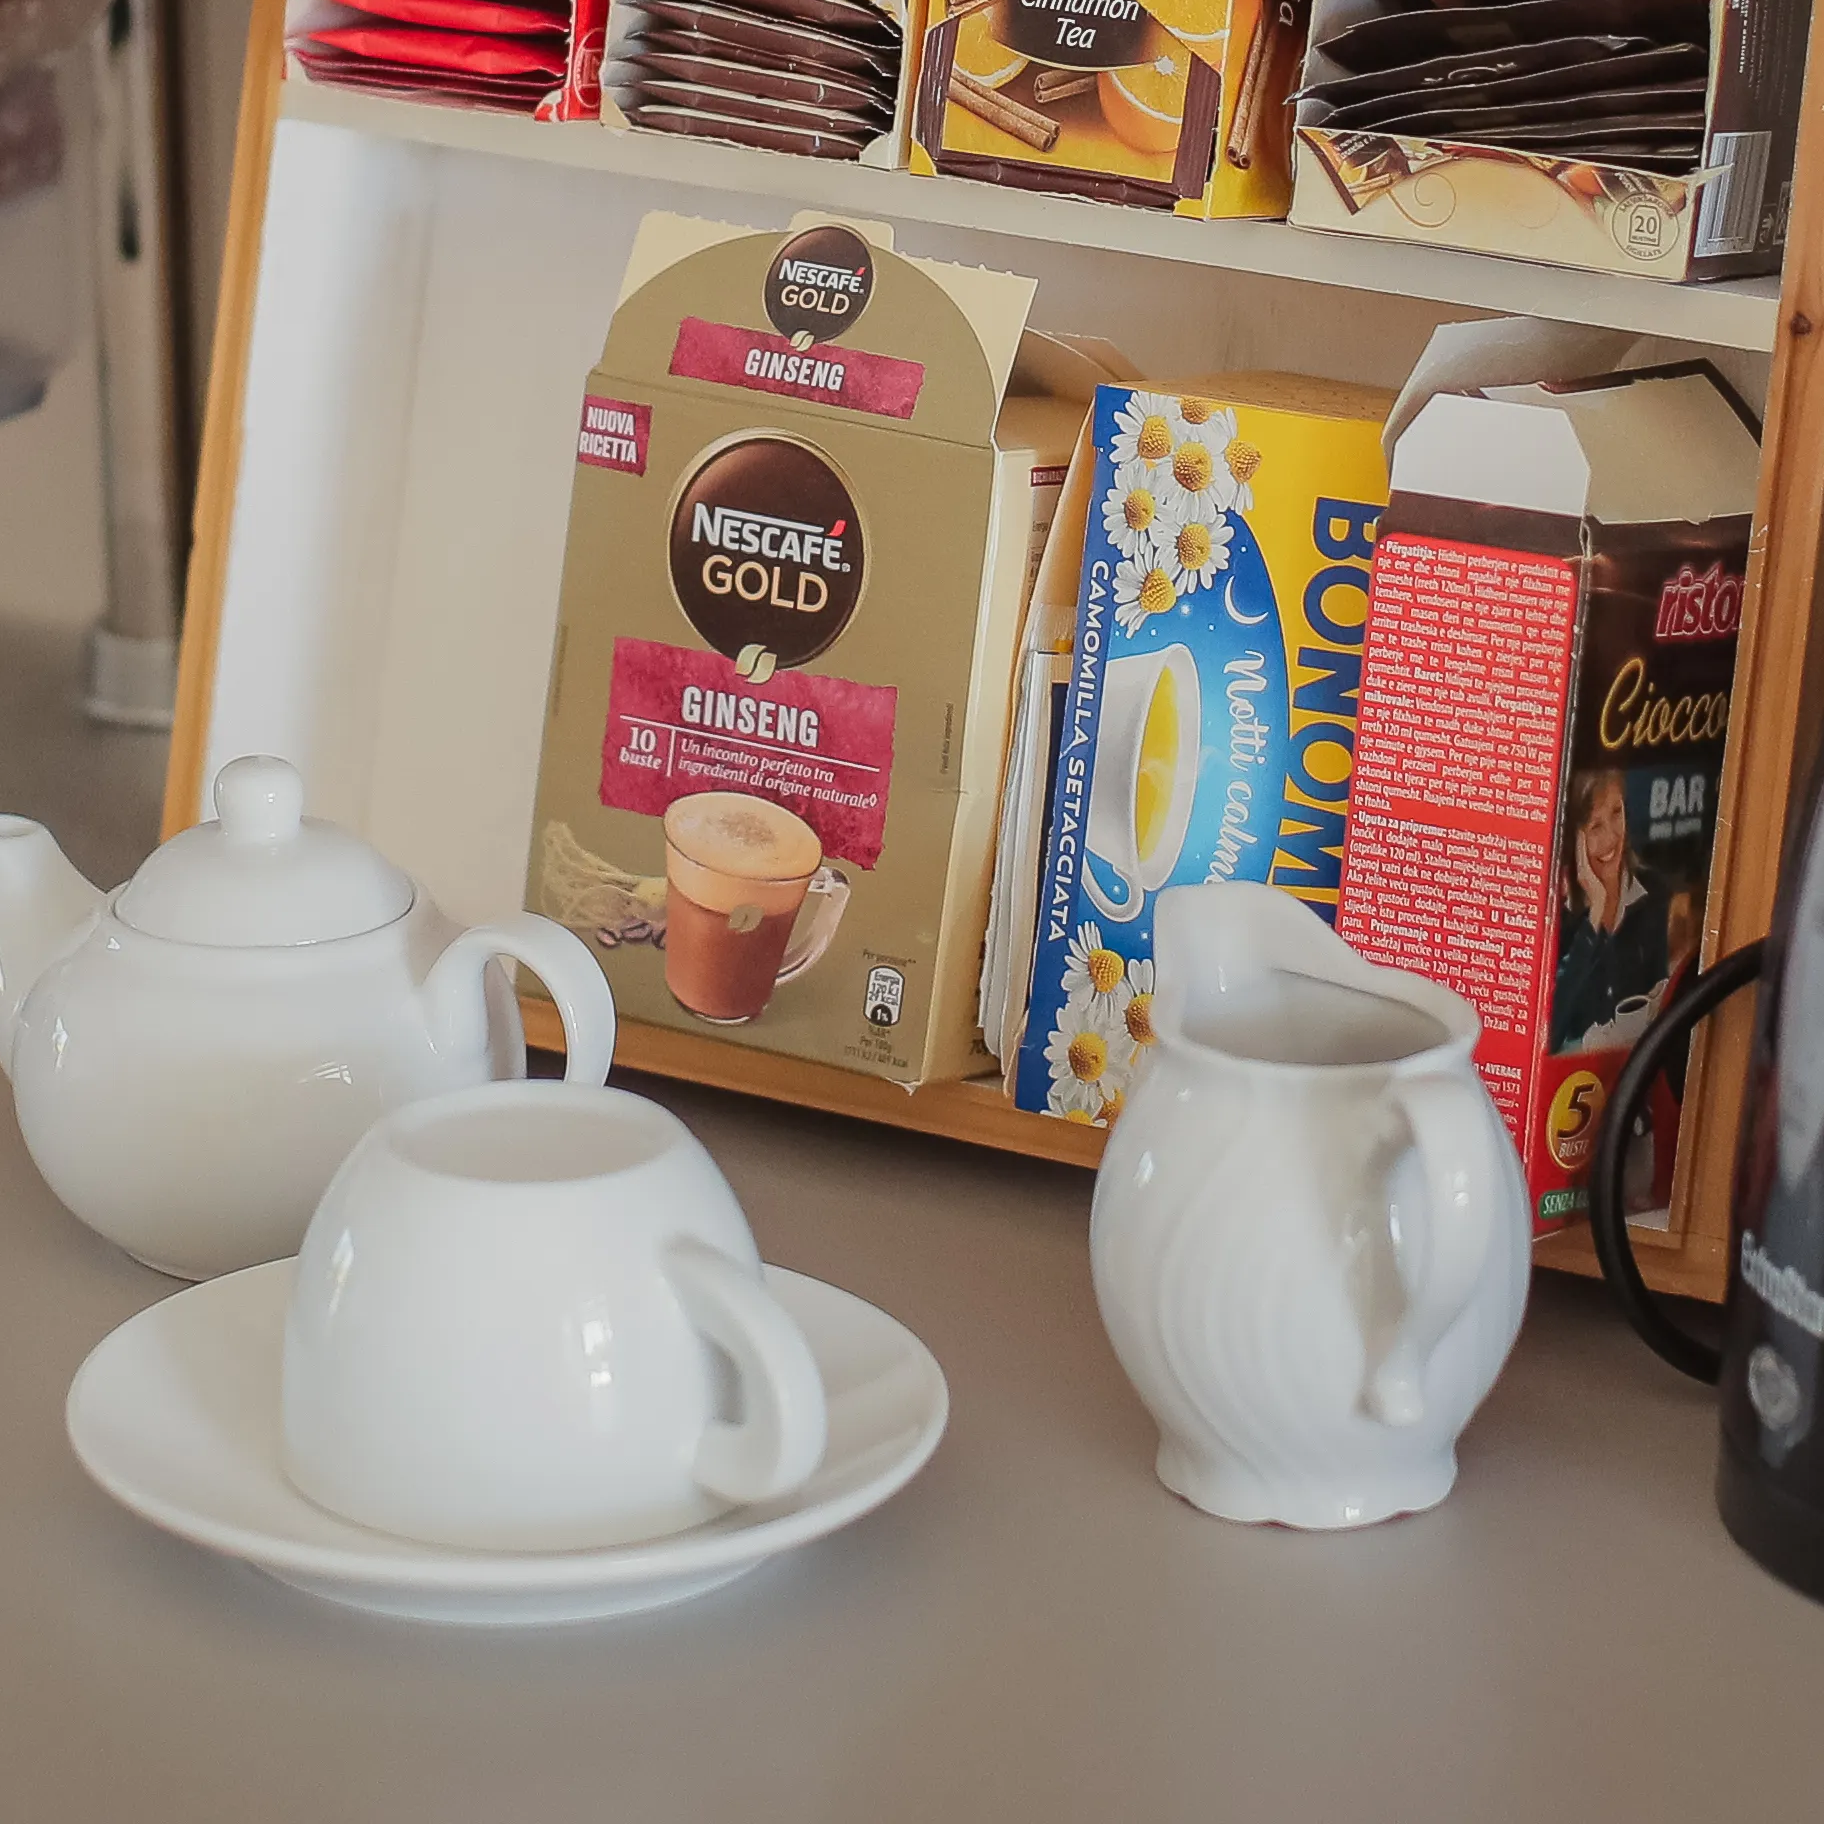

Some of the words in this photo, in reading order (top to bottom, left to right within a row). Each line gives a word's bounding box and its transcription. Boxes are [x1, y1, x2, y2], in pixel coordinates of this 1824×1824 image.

[1054, 17, 1096, 49] Tea
[779, 257, 866, 294] NESCAFÉ
[780, 283, 850, 317] GOLD
[744, 346, 844, 392] GINSENG
[586, 406, 635, 436] NUOVA
[579, 431, 637, 463] RICETTA
[691, 502, 848, 573] NESCAFÉ
[700, 552, 830, 616] GOLD
[1070, 558, 1109, 749] CAMOMILLA
[680, 684, 821, 747] GINSENG
[1211, 648, 1278, 775] Notti
[619, 746, 662, 770] buste
[627, 726, 657, 754] 10
[681, 738, 699, 755] Un
[702, 743, 758, 768] incontro
[759, 755, 811, 781] perfetto
[813, 766, 834, 783] tra
[678, 755, 749, 787] ingredienti
[749, 769, 764, 787] di
[765, 772, 810, 799] origine
[1649, 773, 1706, 819] BAR
[1047, 756, 1085, 944] SETACCIATA
[1558, 1082, 1596, 1140] 5
